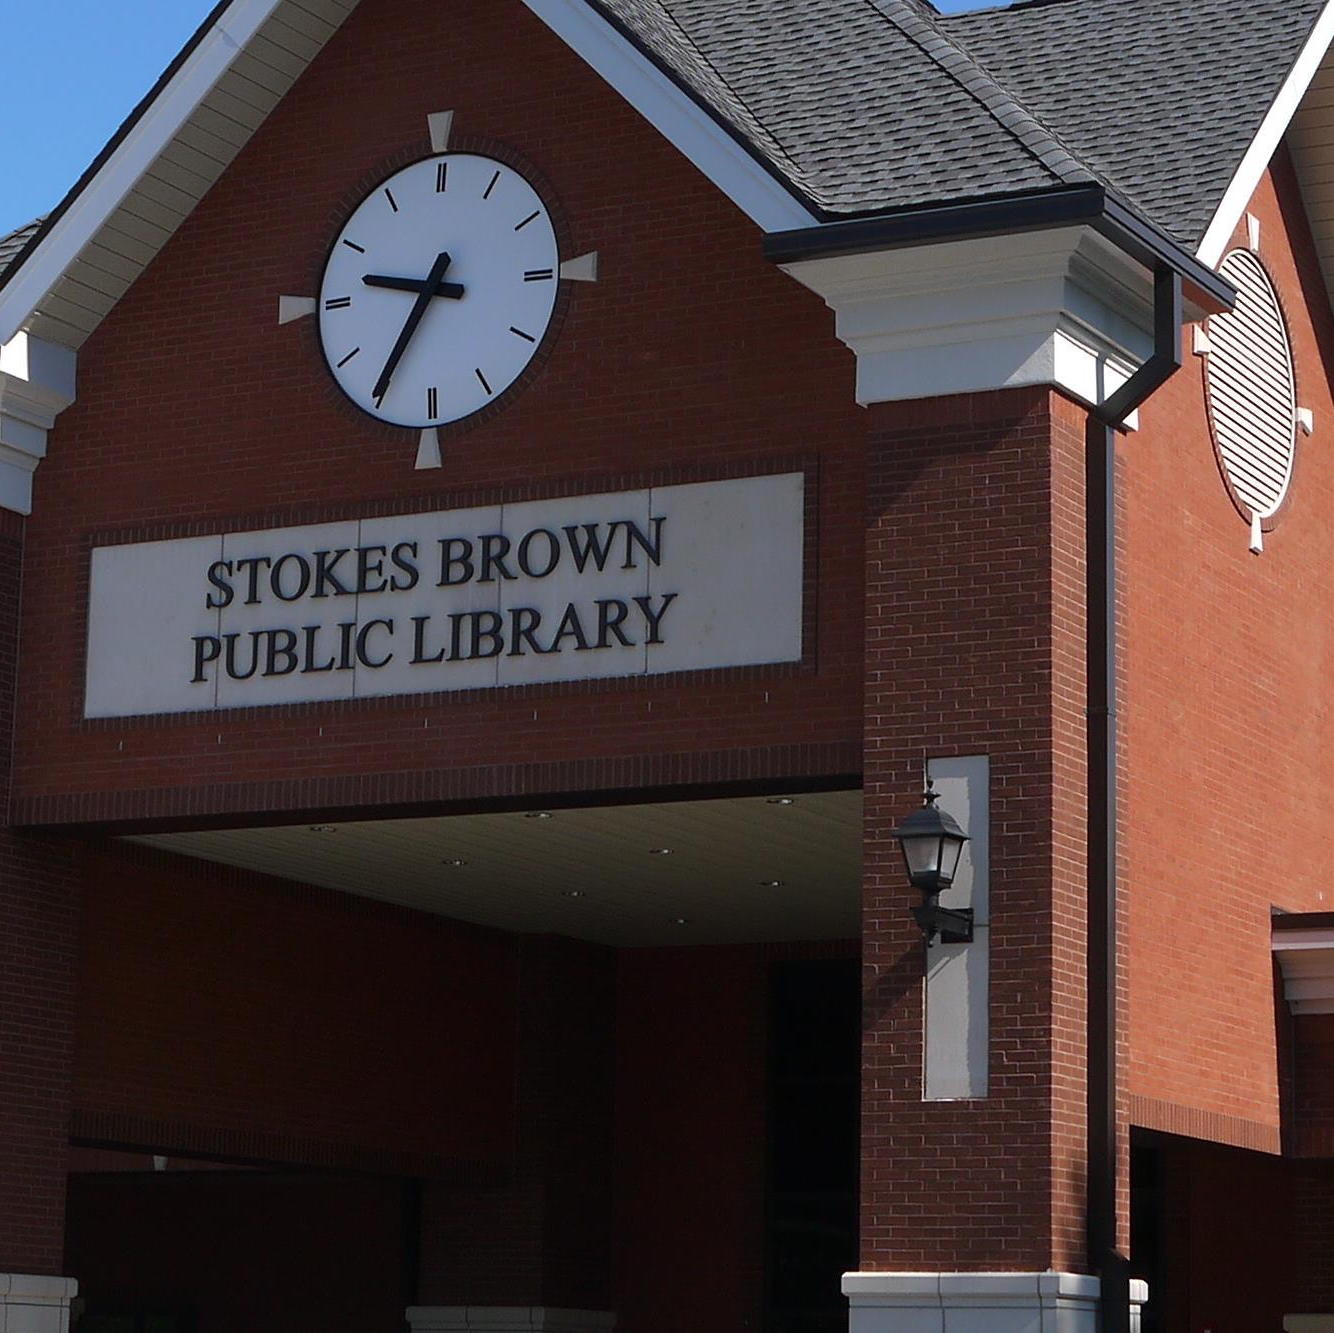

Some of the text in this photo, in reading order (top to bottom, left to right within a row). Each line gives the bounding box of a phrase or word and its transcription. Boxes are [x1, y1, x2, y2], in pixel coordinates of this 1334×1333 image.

[204, 517, 667, 609] STOKES BROWN
[190, 593, 679, 683] PUBLIC LIBRARY
